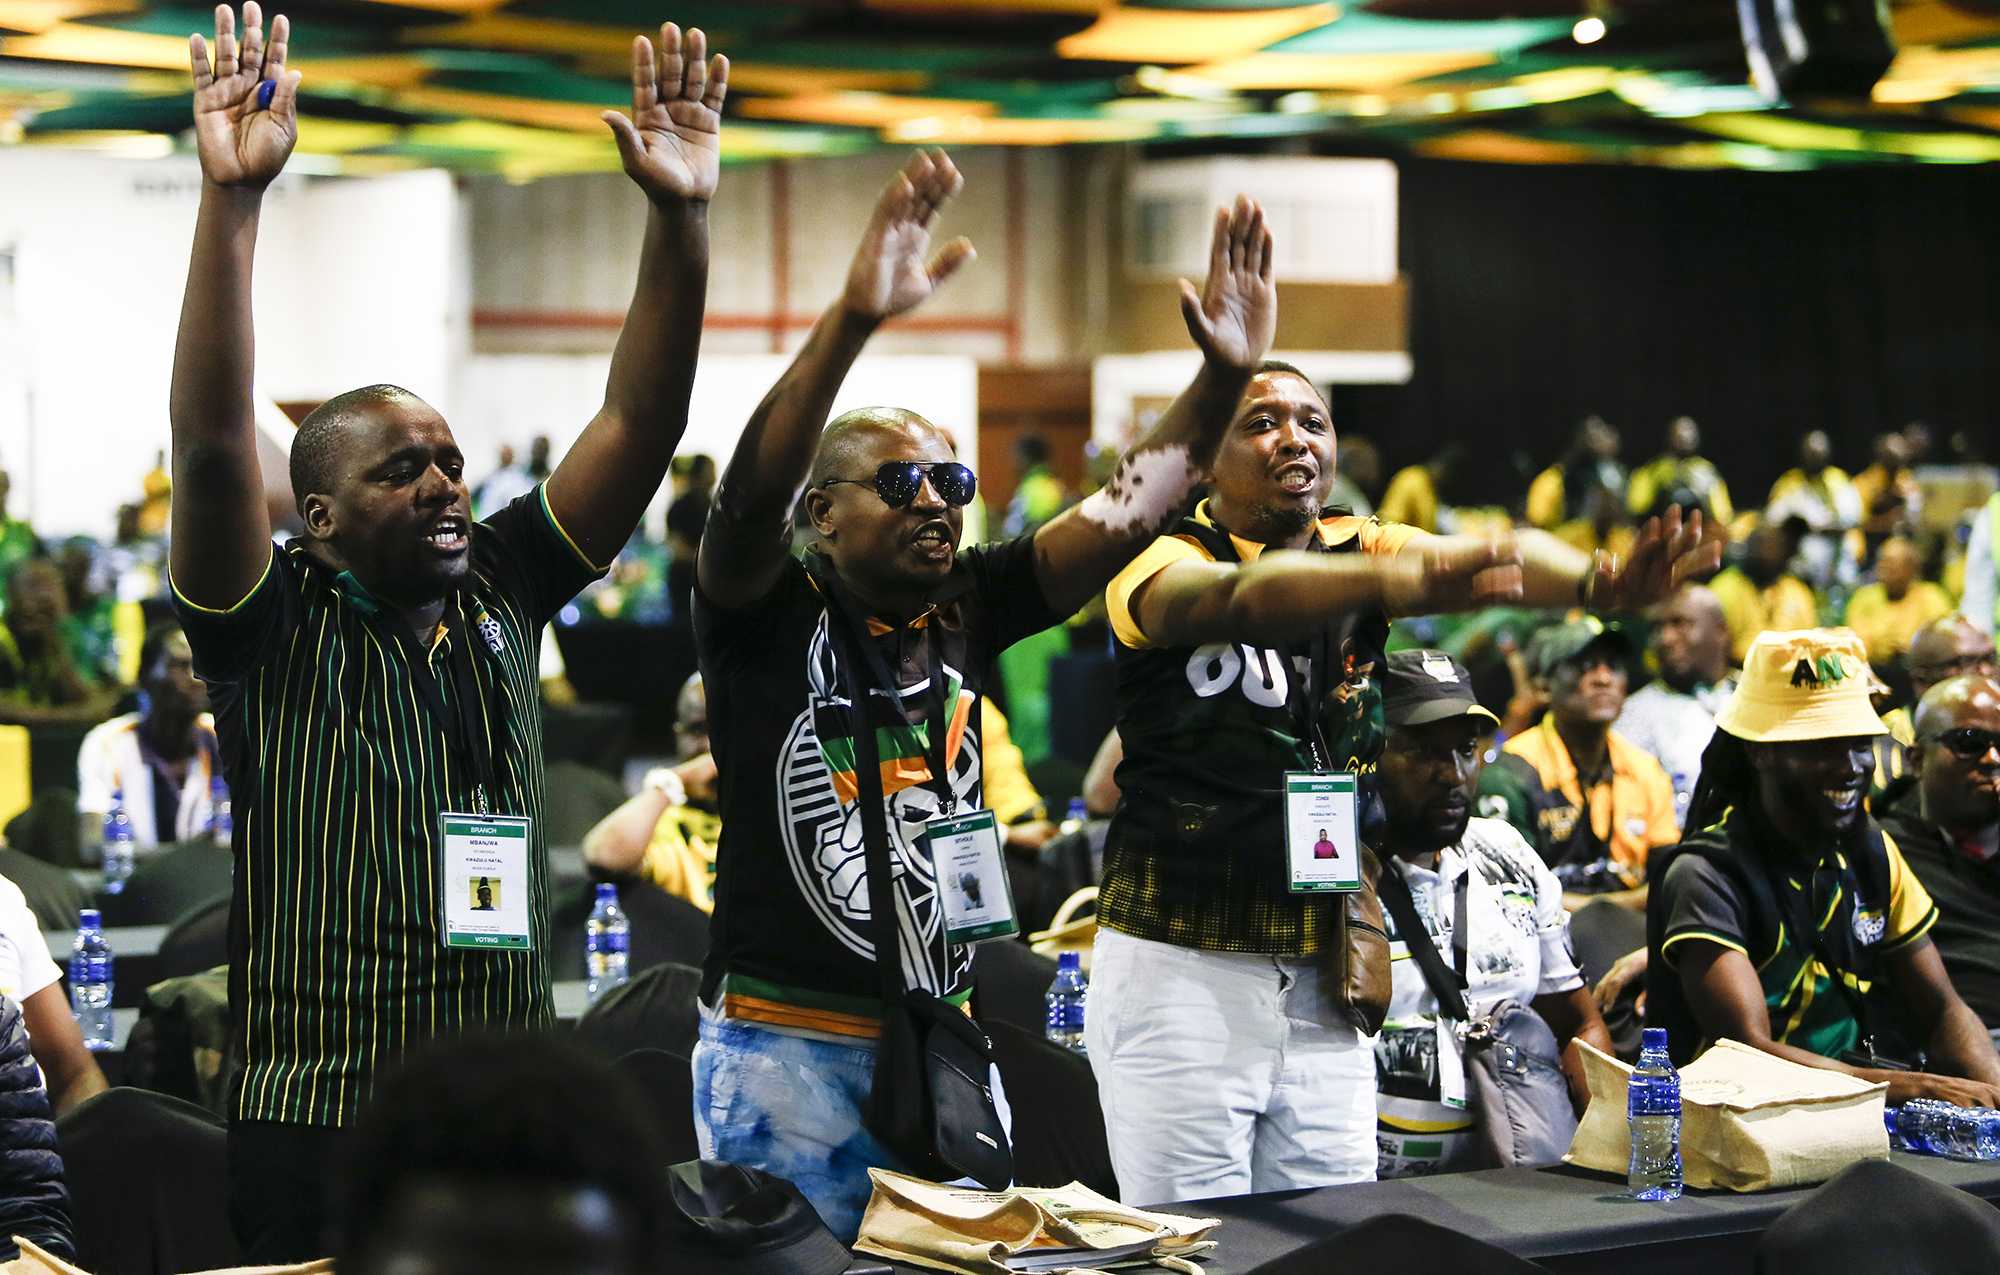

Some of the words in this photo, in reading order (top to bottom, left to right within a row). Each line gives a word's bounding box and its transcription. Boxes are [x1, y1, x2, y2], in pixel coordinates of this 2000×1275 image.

[470, 826, 497, 834] BRANCH
[469, 839, 499, 847] MBANJWA
[474, 936, 499, 944] VOTING
